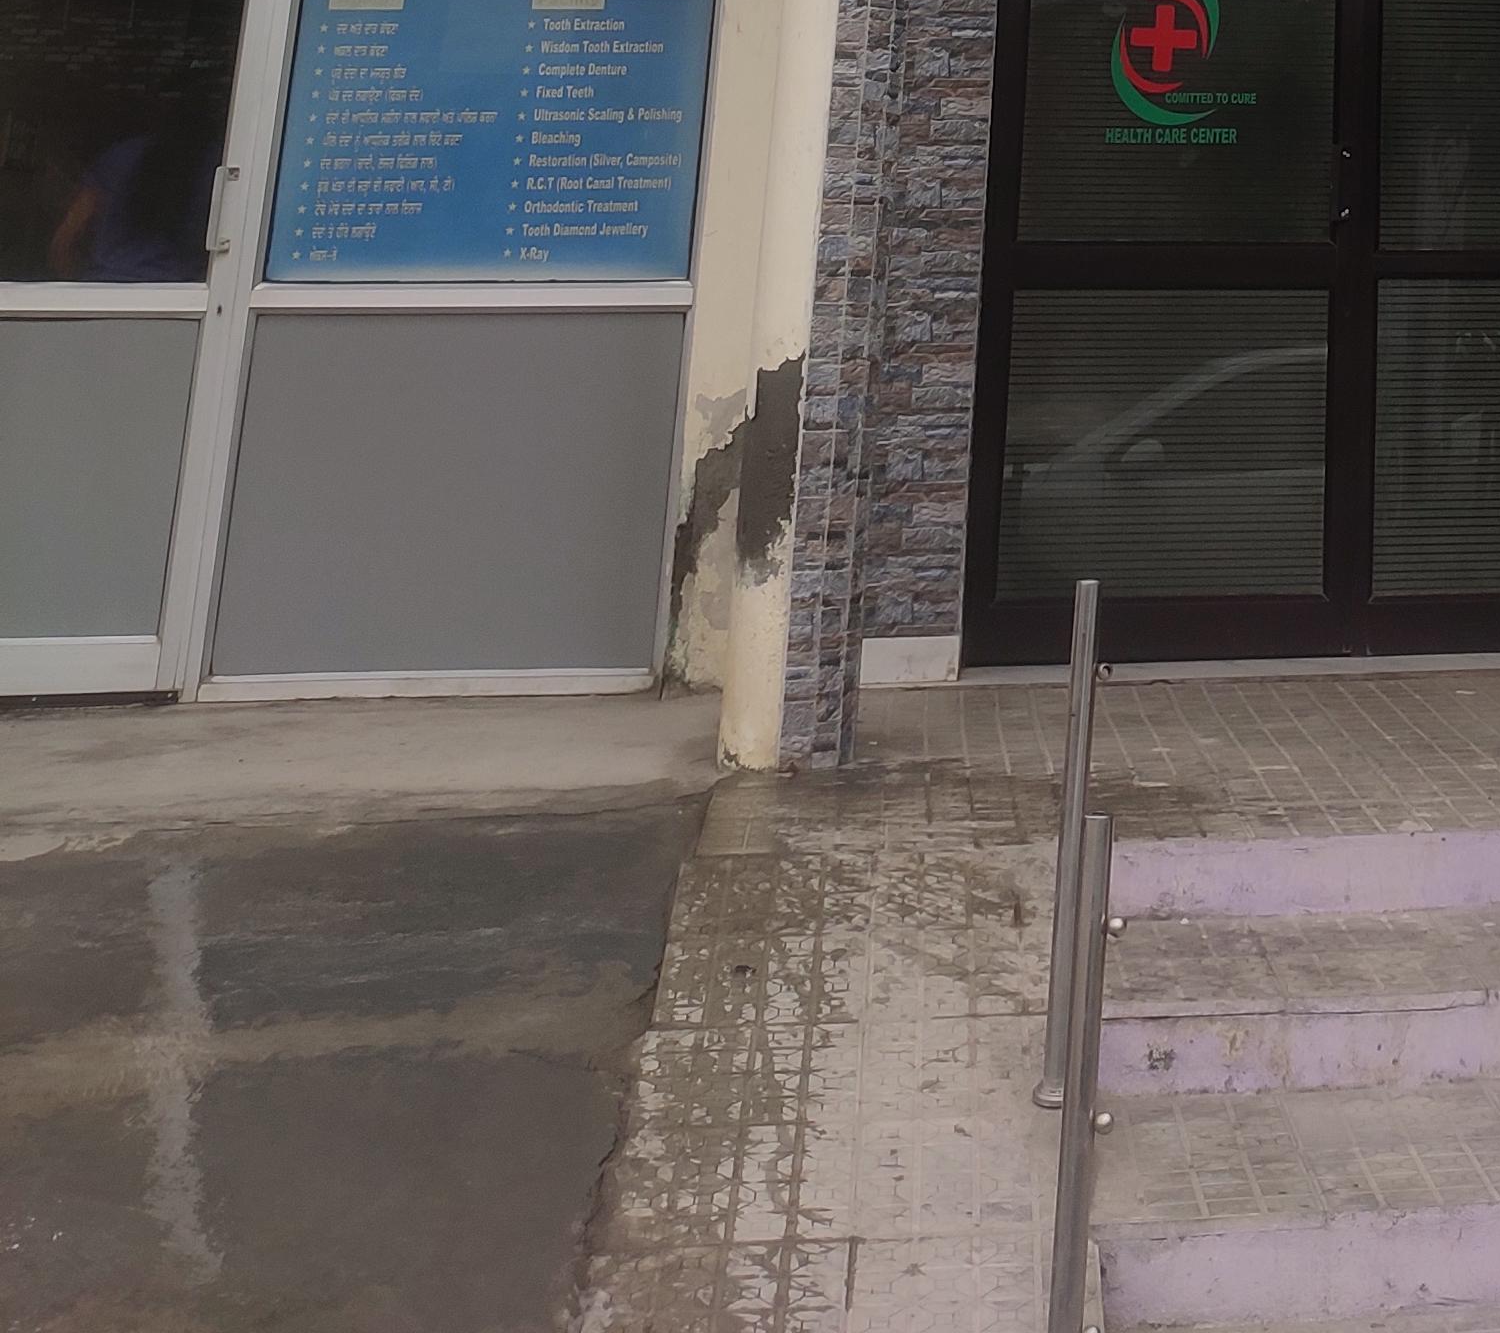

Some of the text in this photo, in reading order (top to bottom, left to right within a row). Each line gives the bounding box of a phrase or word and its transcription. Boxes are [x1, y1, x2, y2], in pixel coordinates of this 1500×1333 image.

[544, 18, 625, 31] Tooth Extraction
[541, 41, 663, 53] Wisdom Tooth Extraction
[539, 63, 627, 77] Complete Denture
[536, 86, 594, 99] Fixed Teeth
[1165, 92, 1257, 105] COMITTED TO CURE
[534, 108, 682, 124] Ultrasonic Scaling & Polishing
[531, 132, 581, 146] Bleaching
[1105, 127, 1238, 144] HEALTH CARE CENTER
[529, 154, 586, 167] Restoration
[586, 177, 614, 190] Canal
[524, 200, 639, 213] Orthodontic Treatment
[523, 223, 648, 238] Tooth Diamond Jewellery
[520, 247, 549, 263] X-Ray
